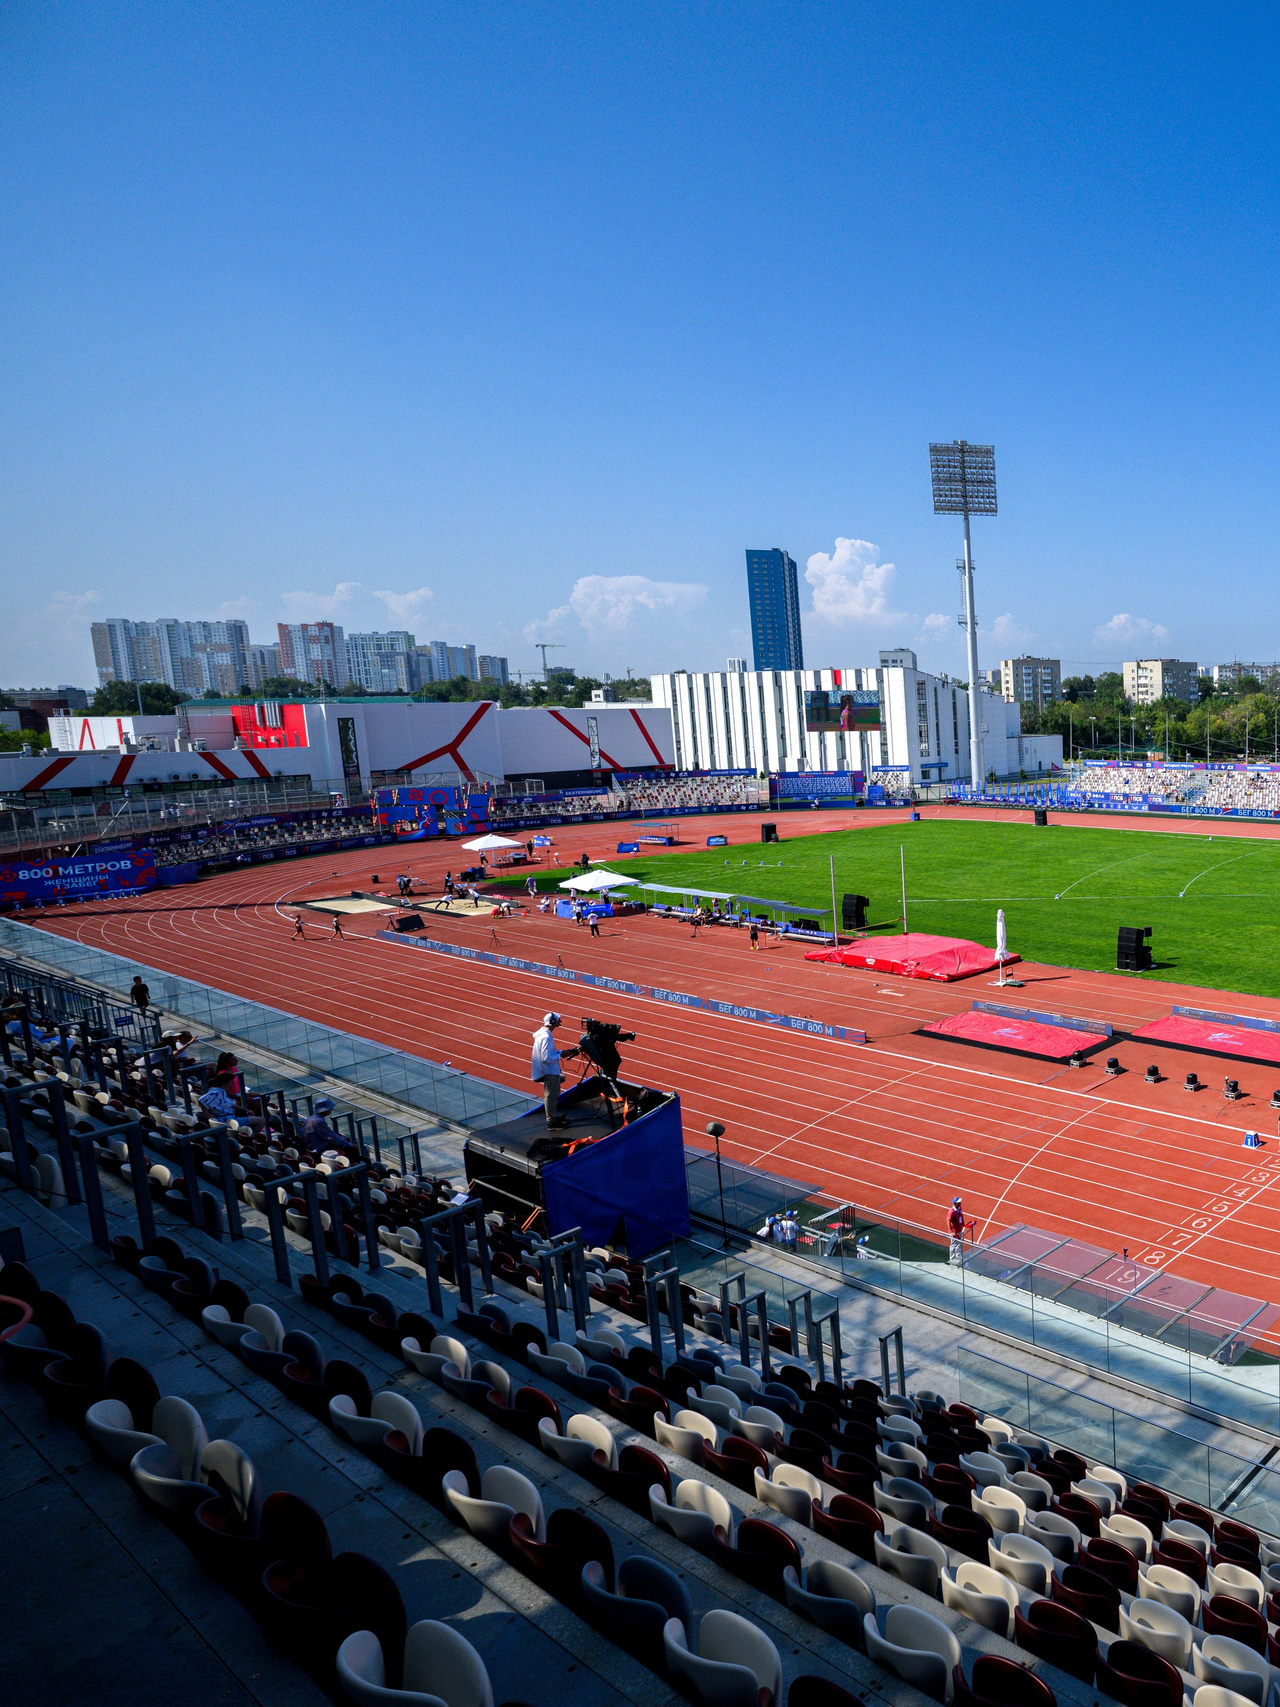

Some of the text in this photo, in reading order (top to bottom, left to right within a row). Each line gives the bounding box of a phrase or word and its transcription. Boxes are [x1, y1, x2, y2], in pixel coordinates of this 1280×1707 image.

[18, 860, 132, 880] 800 МЕТРОВ
[44, 874, 109, 887] ЖЕНЩИНЫ
[63, 881, 97, 890] ЗАБЕГ
[408, 937, 418, 945] БЕГ
[418, 939, 426, 948] 800
[452, 946, 460, 955] БЕГ
[460, 948, 470, 957] 800
[498, 956, 525, 969] БЕГ 800 М
[546, 966, 575, 980] БЕГ 800 М
[595, 977, 626, 991] БЕГ 800 М
[654, 989, 689, 1004] БЕГ 800 М
[719, 1003, 757, 1020] БЕГ 800 М
[791, 1019, 833, 1036] БЕГ 800 М
[1251, 1172, 1271, 1183] 3
[1232, 1186, 1251, 1198] 4
[1212, 1200, 1234, 1213] 5
[1191, 1217, 1213, 1229] 6
[1171, 1232, 1193, 1246] 7
[1143, 1250, 1166, 1265] 8
[1117, 1269, 1141, 1284] 9
